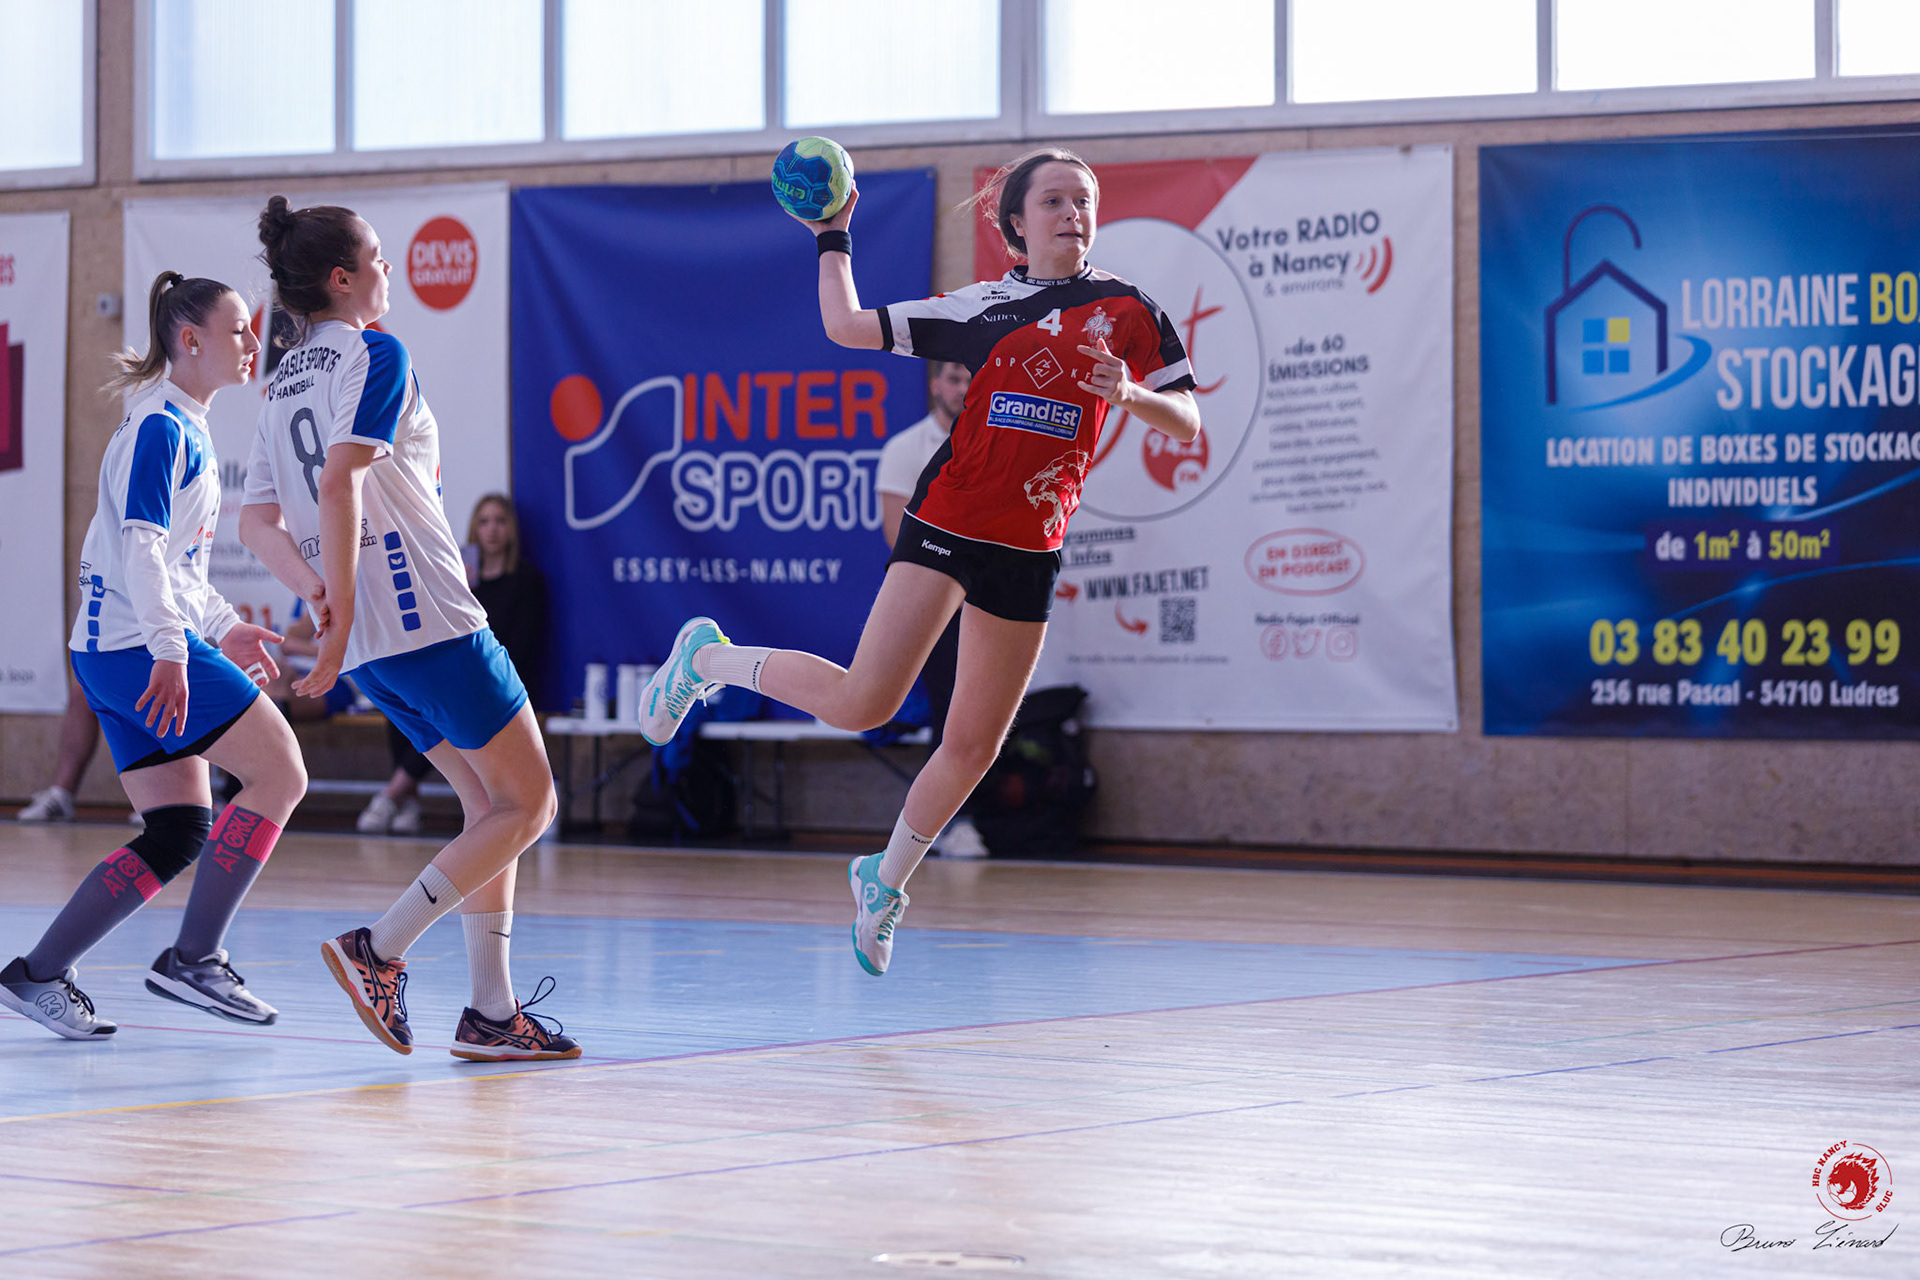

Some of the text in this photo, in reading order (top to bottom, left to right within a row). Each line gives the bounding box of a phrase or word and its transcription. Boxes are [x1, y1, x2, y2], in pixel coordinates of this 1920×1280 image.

[1216, 210, 1380, 251] Votre RADIO
[412, 239, 475, 266] DEVIS
[1249, 250, 1350, 278] à Nancy
[412, 267, 473, 287] GRATUIT
[1036, 278, 1056, 286] NANCY
[1681, 271, 1920, 330] LORRAINE BO
[1037, 308, 1063, 337] 4
[1321, 334, 1345, 353] 60
[305, 346, 342, 374] SPORTS
[275, 375, 315, 401] HANDBALL
[1716, 342, 1920, 411] STOCKAG
[683, 370, 888, 442] INTER
[1546, 437, 1655, 467] LOCATION
[1662, 436, 1694, 465] DE
[1701, 433, 1778, 465] BOXES
[1785, 433, 1817, 462] DE
[671, 450, 884, 532] SPORT
[1668, 475, 1818, 507] INDIVIDUELS
[921, 539, 952, 556] Kempa
[1656, 530, 1686, 560] de
[1747, 530, 1762, 560] à
[612, 556, 843, 583] ESSEY-LES-NANCY
[1084, 565, 1210, 603] WWW.FAJET.NET
[1589, 618, 1902, 665] 03 83 40 23 99
[1591, 679, 1631, 706] 256
[1637, 684, 1672, 706] rue
[1678, 679, 1740, 706] Pascal
[1760, 679, 1824, 706] 54710
[1830, 679, 1899, 707] Ludres
